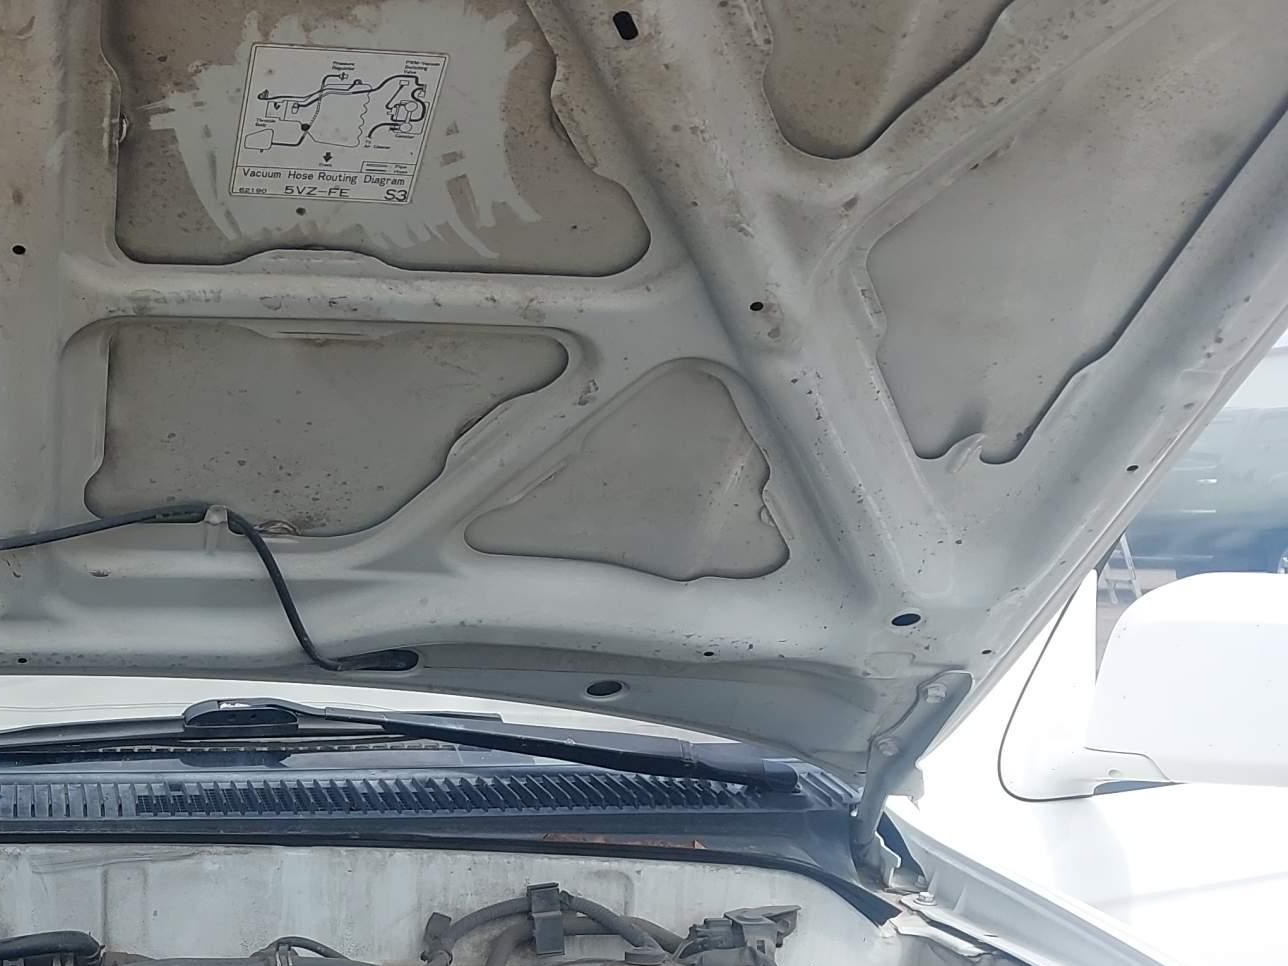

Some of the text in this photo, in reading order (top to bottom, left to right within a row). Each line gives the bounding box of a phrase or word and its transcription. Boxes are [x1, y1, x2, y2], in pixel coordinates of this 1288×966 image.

[242, 168, 405, 187] Vacuum Hose Routing Diagram
[284, 185, 351, 198] 5VZ-FE
[384, 189, 408, 202] S3
